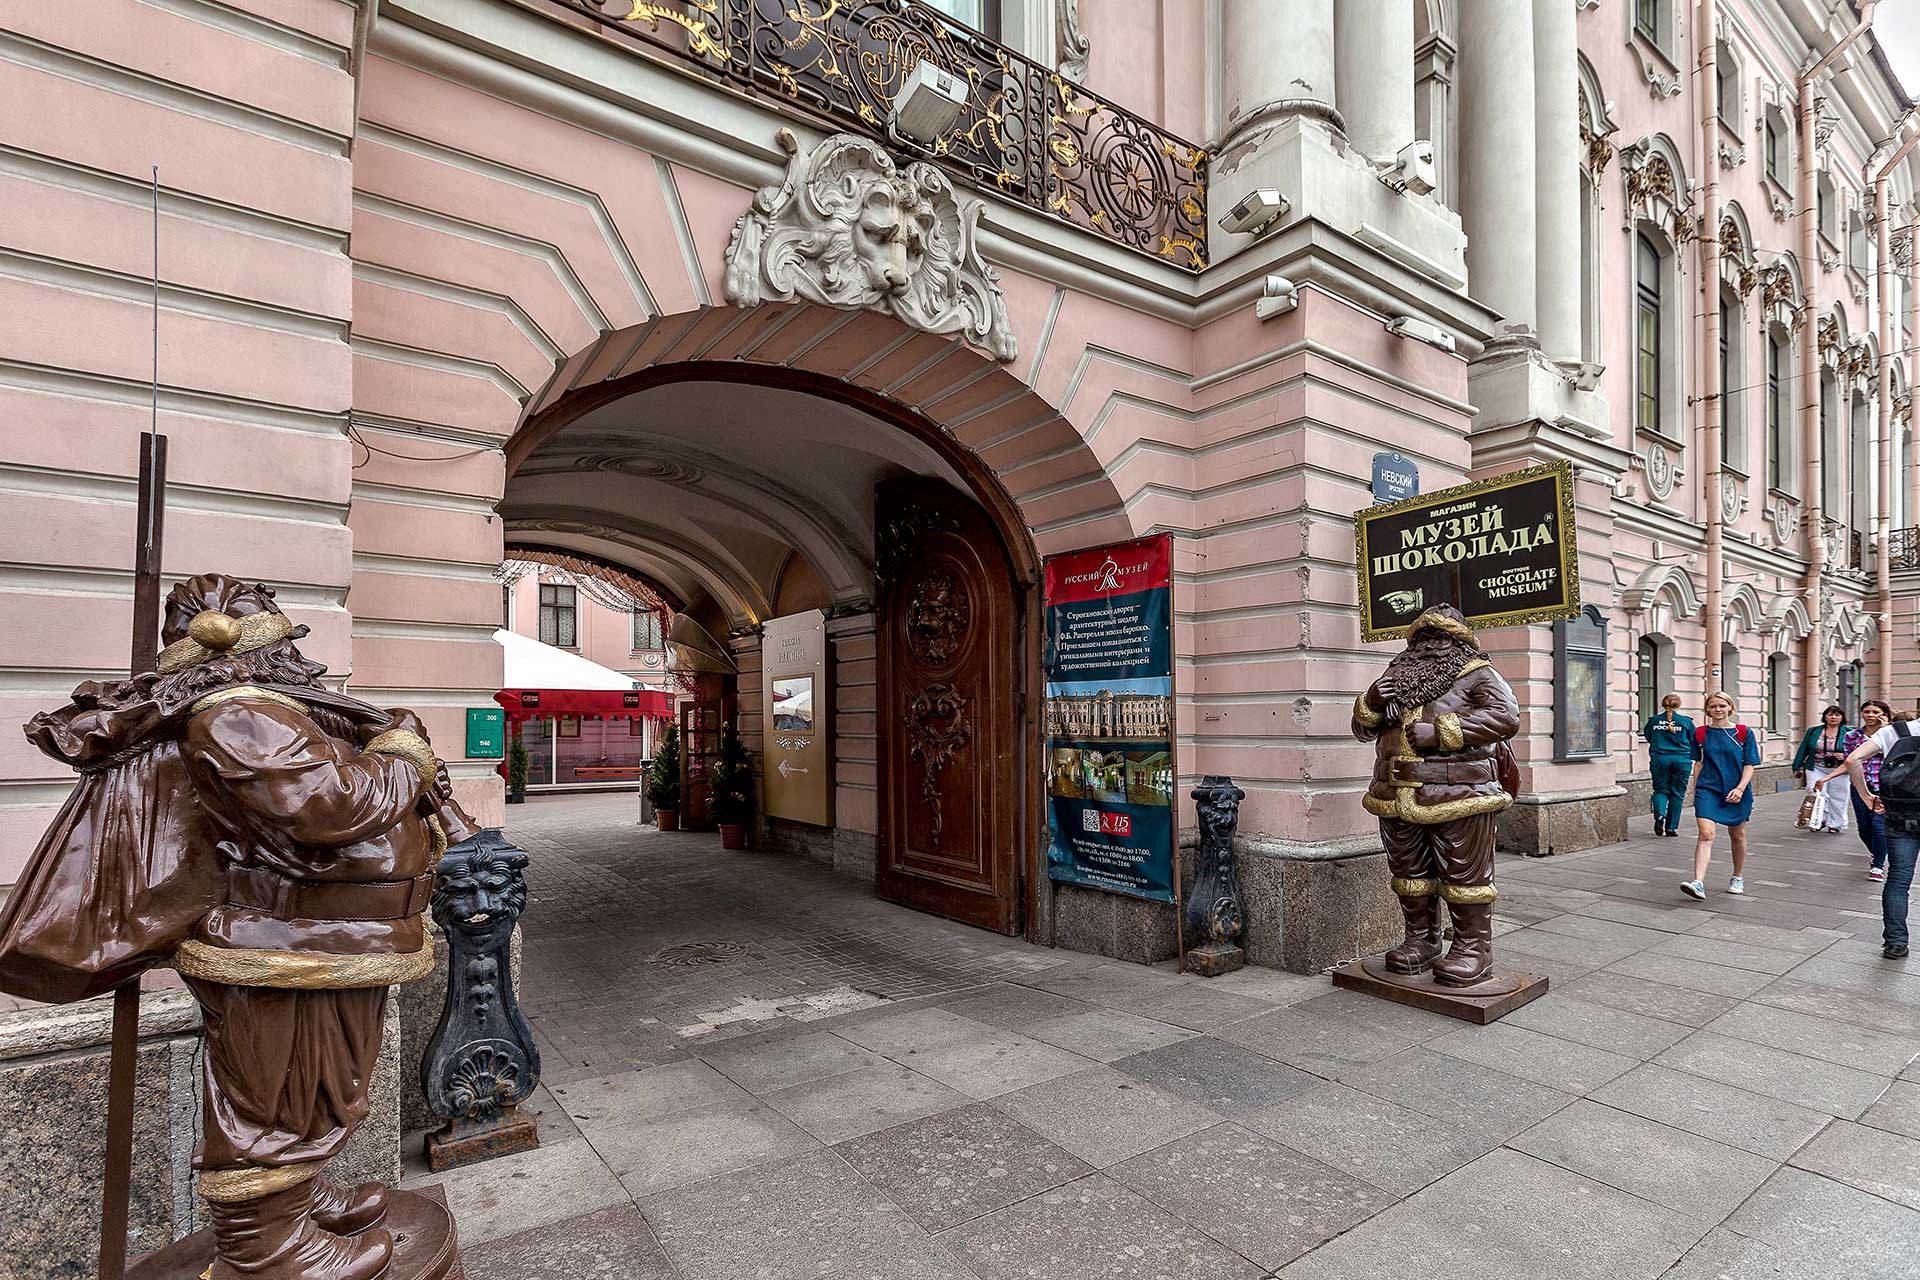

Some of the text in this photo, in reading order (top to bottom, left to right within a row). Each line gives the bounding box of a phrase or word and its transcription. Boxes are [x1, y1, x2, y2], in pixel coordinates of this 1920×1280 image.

[1381, 469, 1412, 488] НЕВСКИЙ
[1430, 501, 1477, 518] МАГАЗИН
[1400, 504, 1504, 549] МУЗЕЙ
[1373, 523, 1554, 576] ШОКОЛАДА
[1064, 561, 1148, 584] РУССКИЙ МУЗЕЙ
[1478, 567, 1557, 589] CHOCOLATE
[1502, 566, 1530, 575] BOUTIQUE
[1488, 580, 1547, 599] MUSEUM
[1066, 607, 1113, 621] Строгановский
[1113, 605, 1134, 615] дворец
[1069, 617, 1117, 630] архитектурный
[1073, 630, 1104, 640] Растрелли
[1105, 628, 1122, 636] эпохи
[1061, 641, 1100, 651] Приглашаем
[1102, 636, 1142, 647] ознакомиться
[1060, 651, 1103, 661] уникальными
[1104, 648, 1143, 658] интерьерами
[1061, 656, 1150, 671] художественной коллекцией
[1113, 816, 1129, 829] 115
